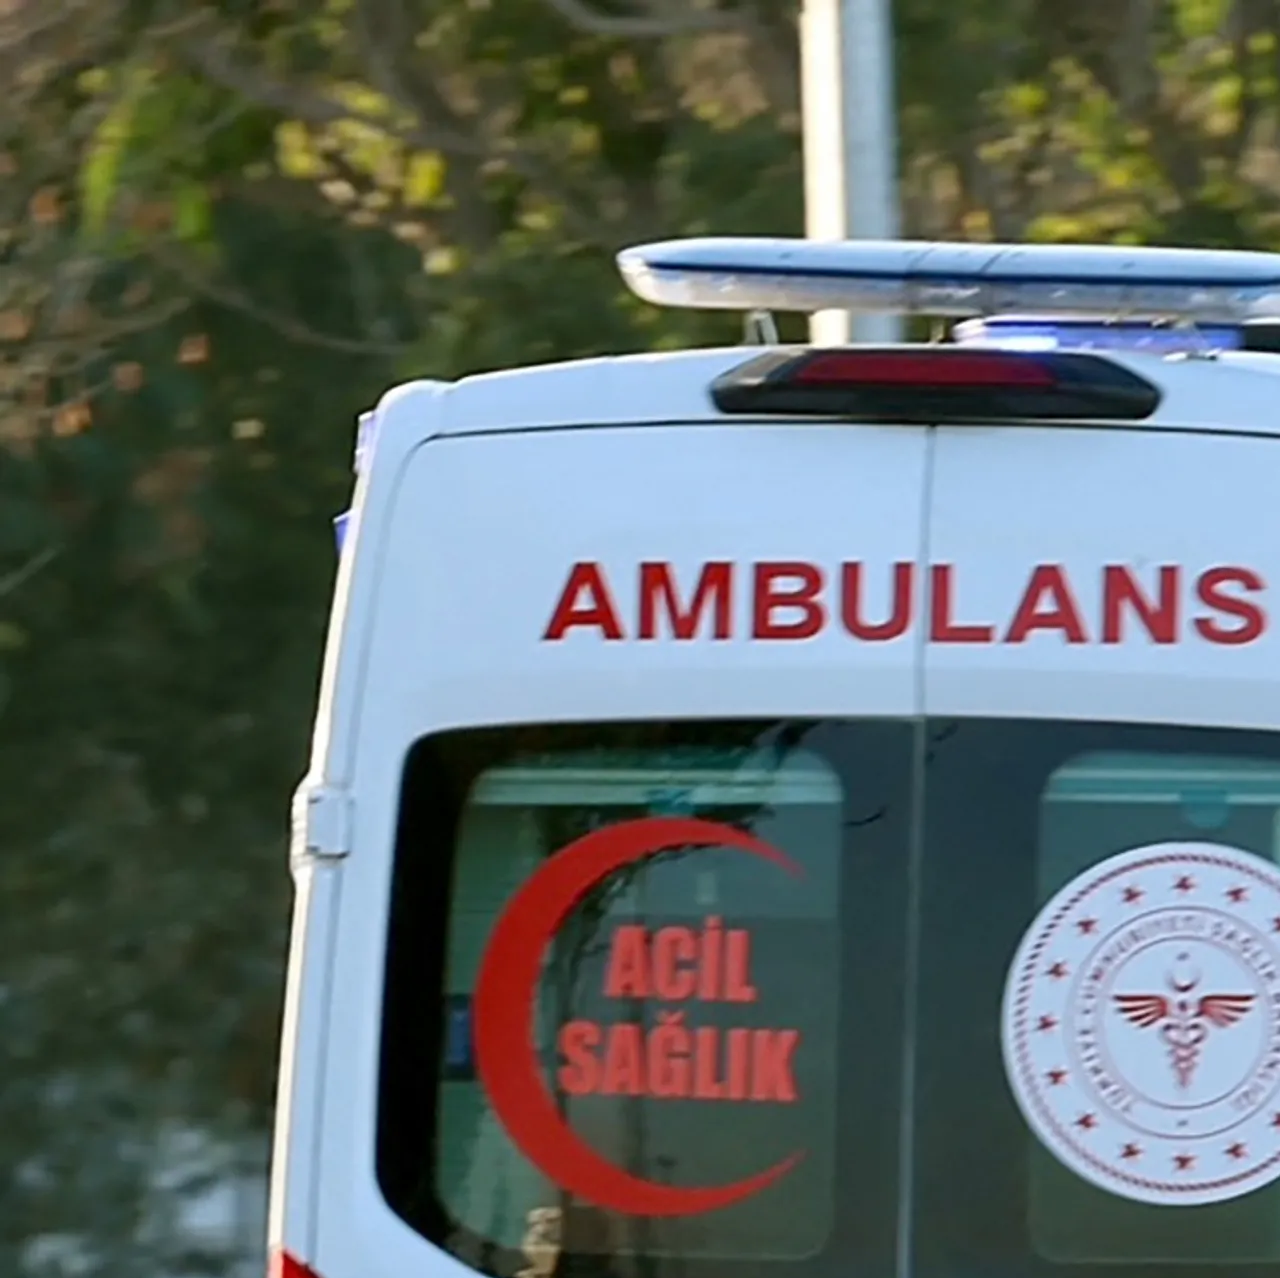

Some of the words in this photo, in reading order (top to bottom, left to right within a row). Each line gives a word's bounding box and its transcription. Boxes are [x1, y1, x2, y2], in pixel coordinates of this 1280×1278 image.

[542, 560, 1268, 645] AMBULANS
[605, 915, 758, 1002] ACİL
[557, 1010, 800, 1102] SAĞLIK
